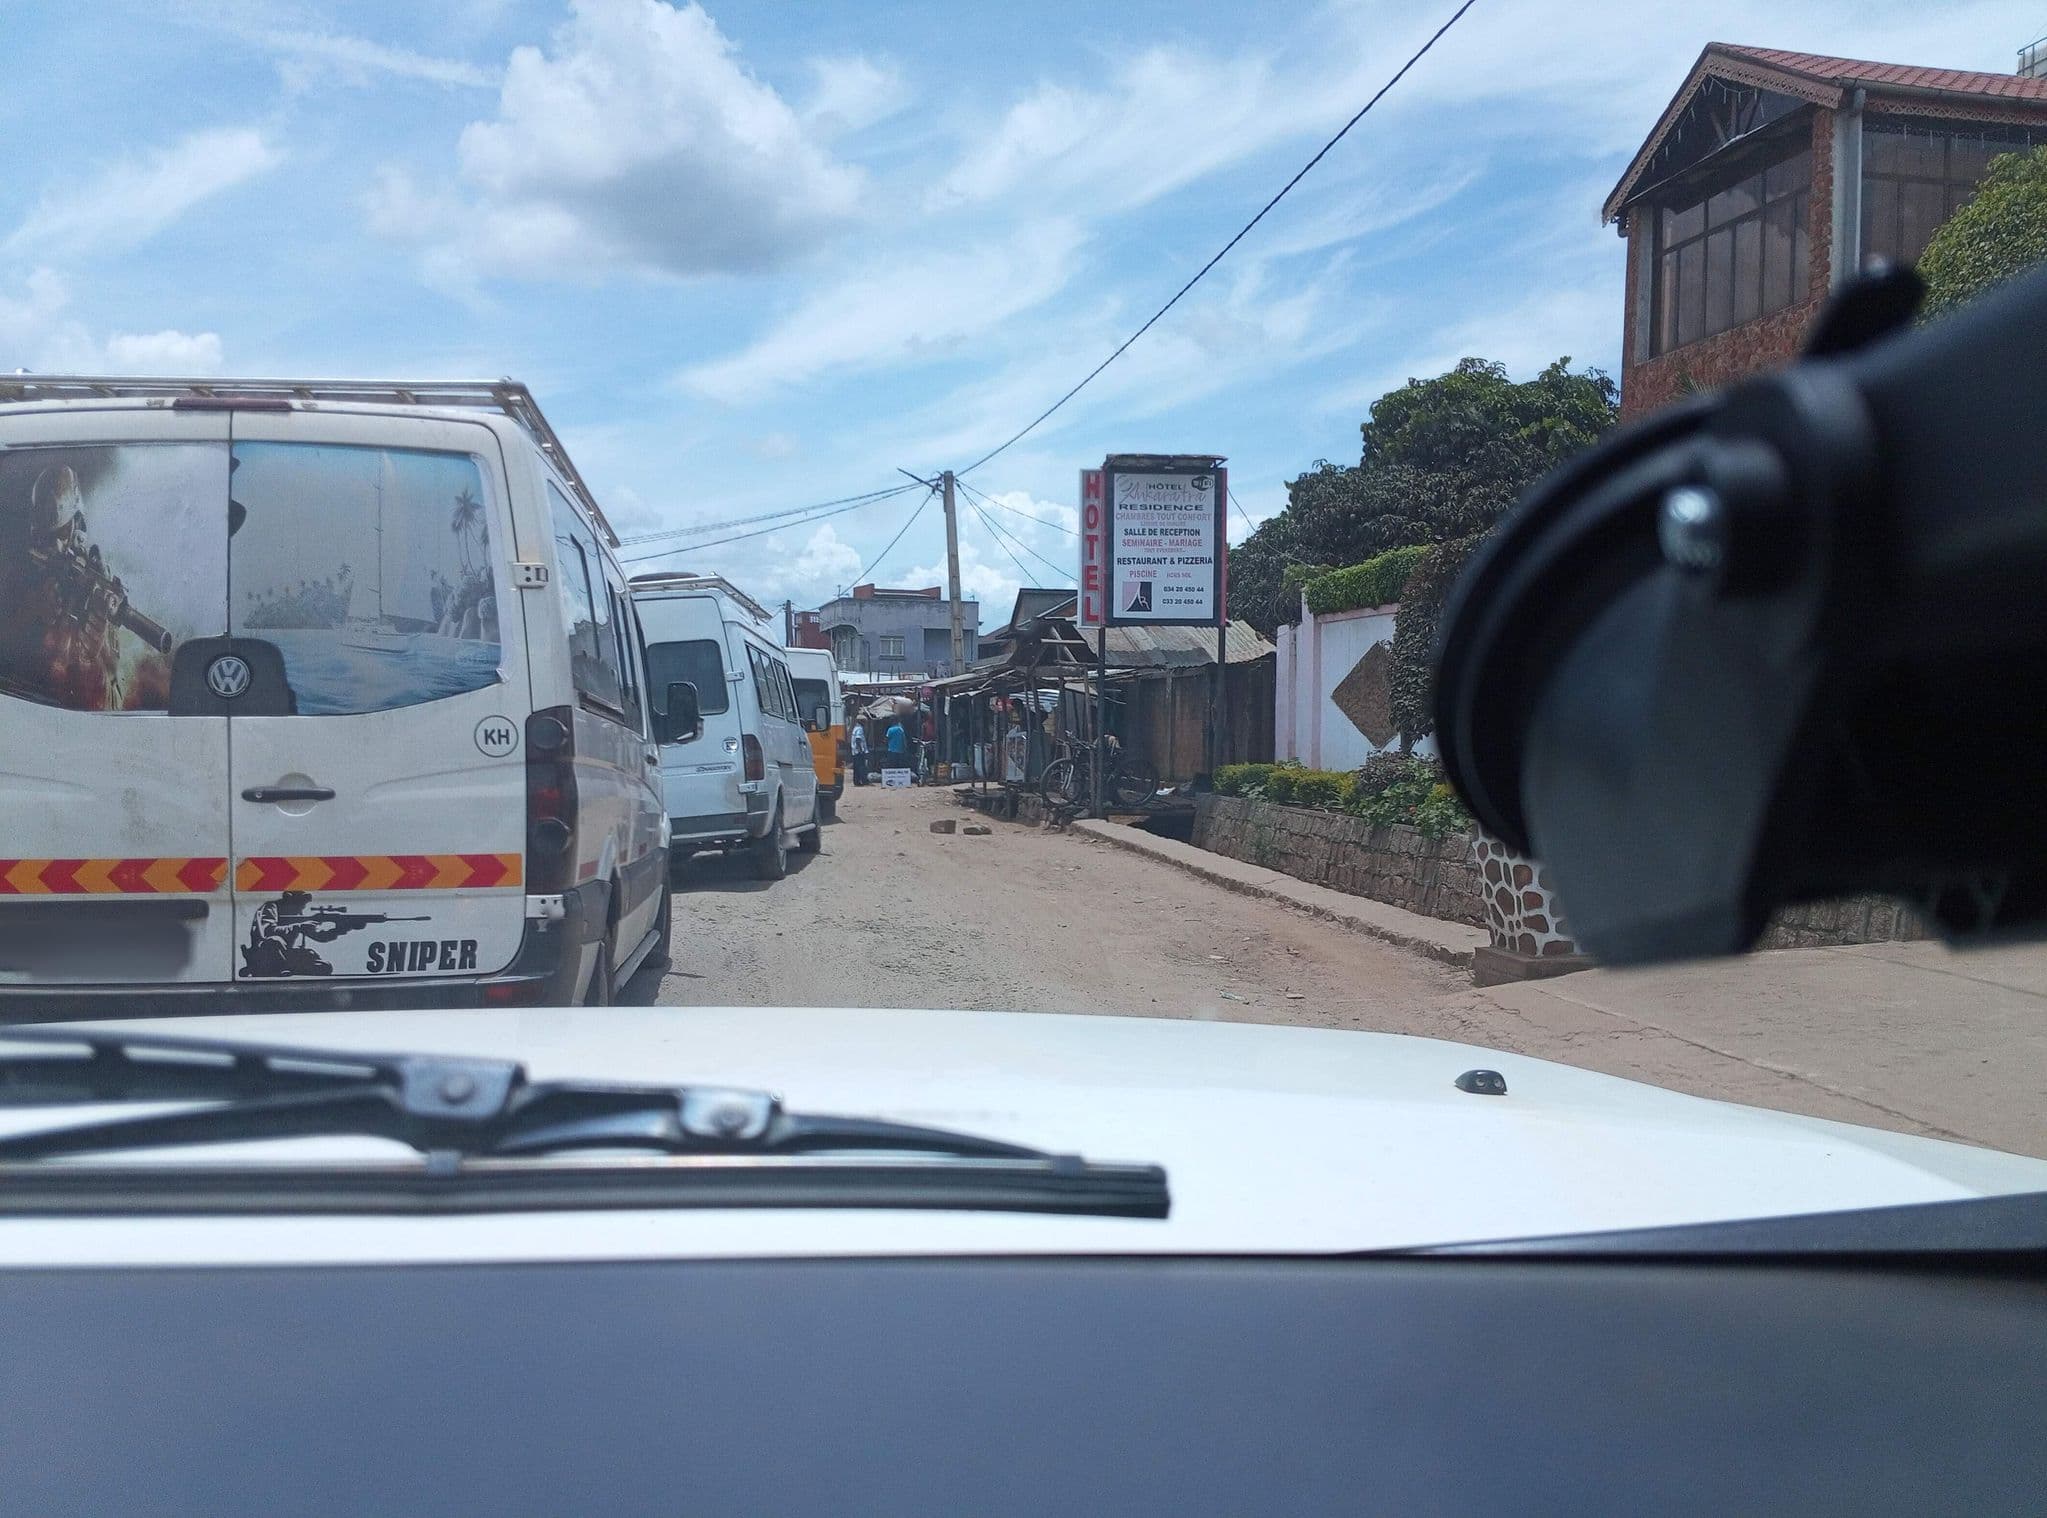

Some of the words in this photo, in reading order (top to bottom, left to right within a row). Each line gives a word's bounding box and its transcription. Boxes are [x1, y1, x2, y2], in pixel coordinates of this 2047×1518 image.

[1118, 503, 1205, 512] RESIDENCE
[1157, 512, 1176, 521] TOUT
[1177, 512, 1213, 521] CONFORT
[1123, 528, 1146, 536] SALLE
[1147, 528, 1158, 536] DE
[1159, 528, 1201, 537] RECEPTION
[1085, 472, 1099, 622] HOTEL
[1168, 538, 1203, 547] MARIAGE
[1117, 557, 1168, 565] RESTAURANT
[1169, 557, 1176, 565] &
[1178, 556, 1212, 565] PIZZERIA
[1129, 570, 1157, 578] PISCINE
[484, 728, 510, 745] KH
[366, 939, 478, 973] SNIPER
